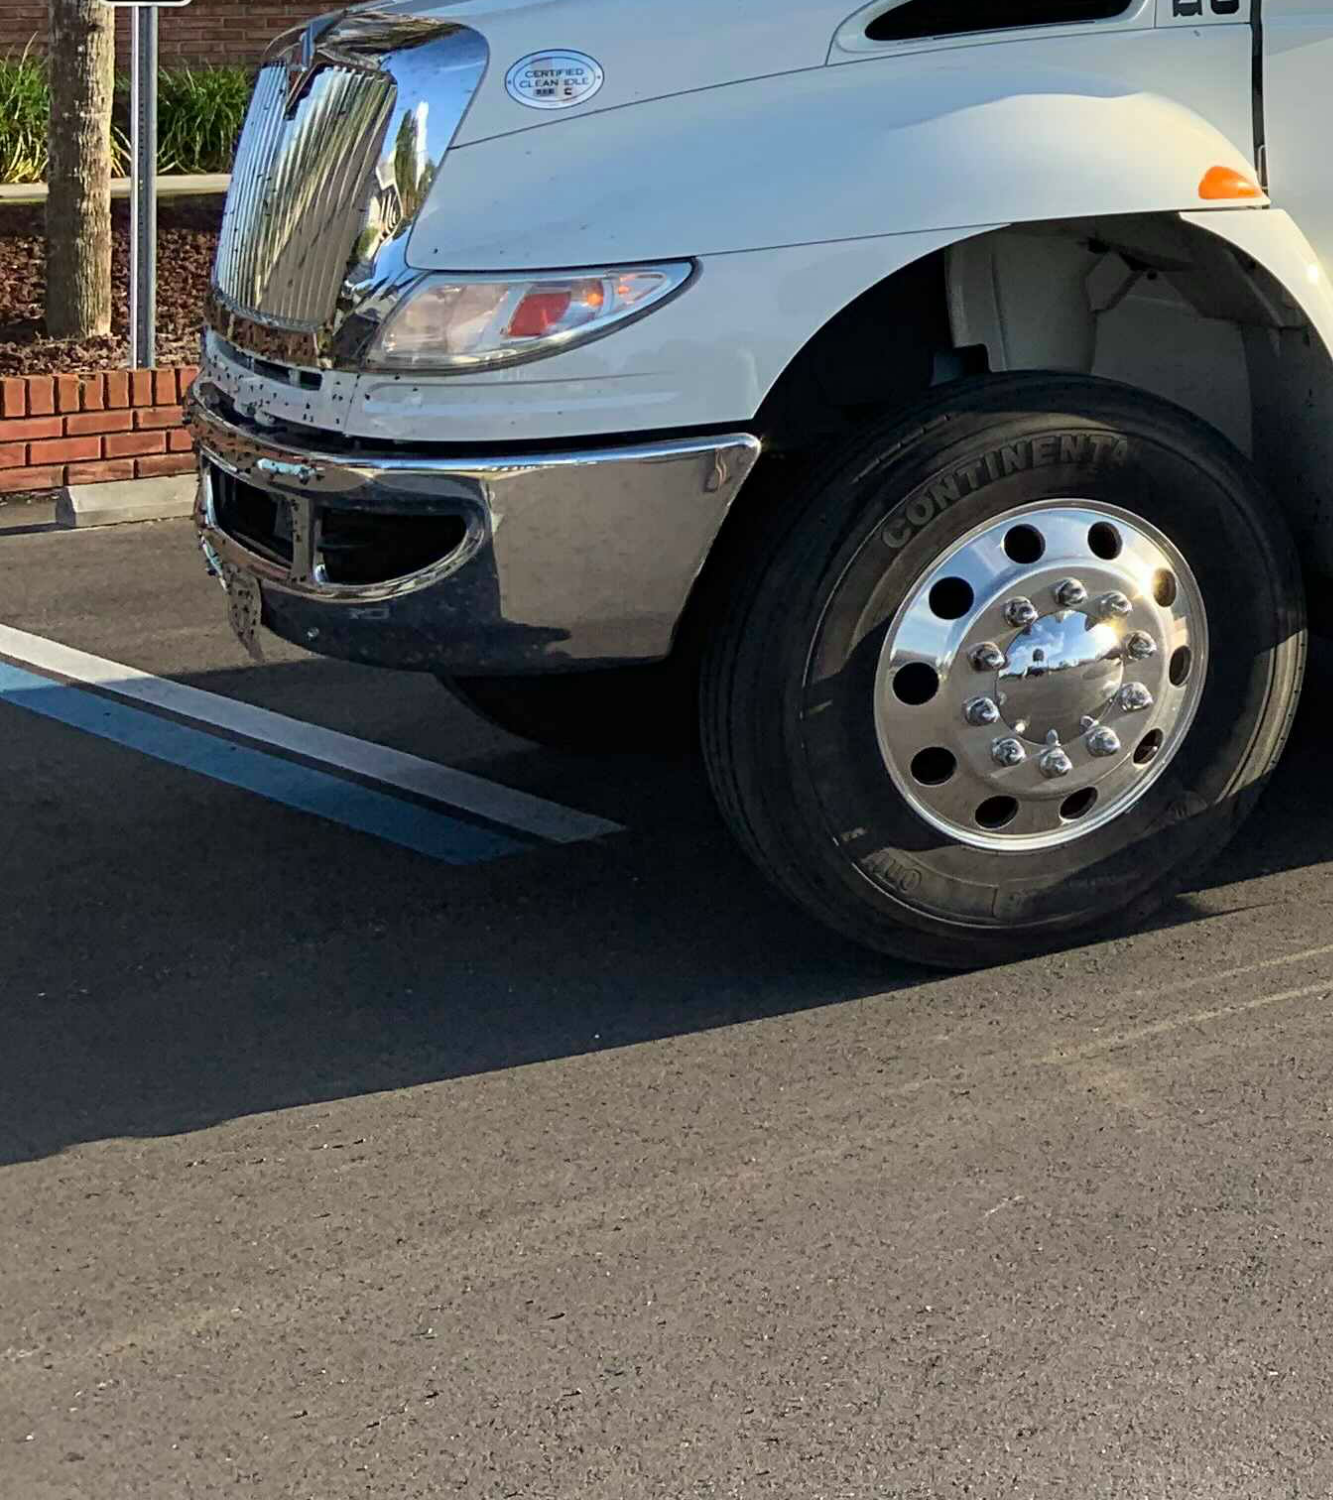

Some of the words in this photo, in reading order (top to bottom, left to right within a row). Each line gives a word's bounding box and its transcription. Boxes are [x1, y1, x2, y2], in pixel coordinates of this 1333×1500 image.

[525, 68, 584, 79] CERTIFIED
[519, 79, 559, 89] CLEAN
[564, 77, 589, 86] IDLE
